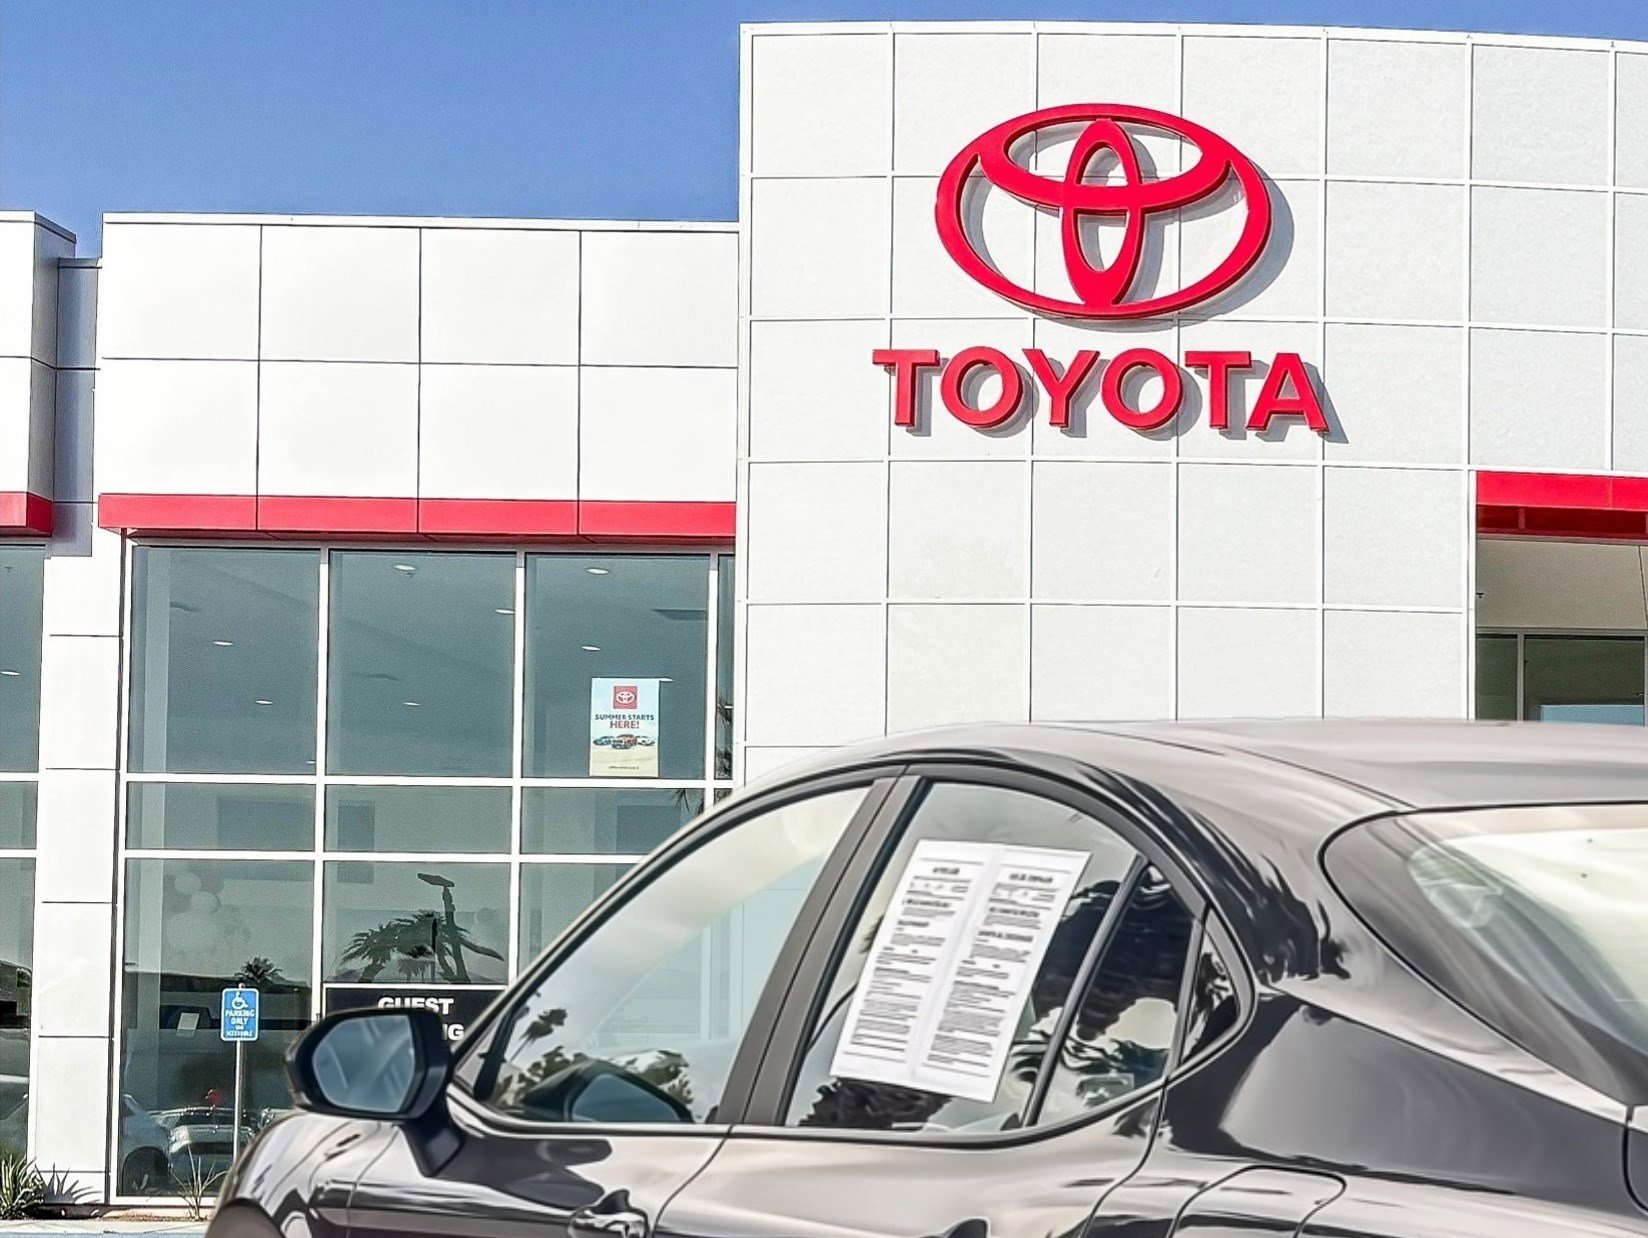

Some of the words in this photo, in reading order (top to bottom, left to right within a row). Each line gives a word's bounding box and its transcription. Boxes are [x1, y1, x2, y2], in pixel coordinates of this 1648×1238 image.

[872, 345, 1330, 434] TOYOTA
[594, 713, 626, 721] SUMMER
[628, 713, 655, 721] STARTS
[609, 721, 640, 729] HERE!
